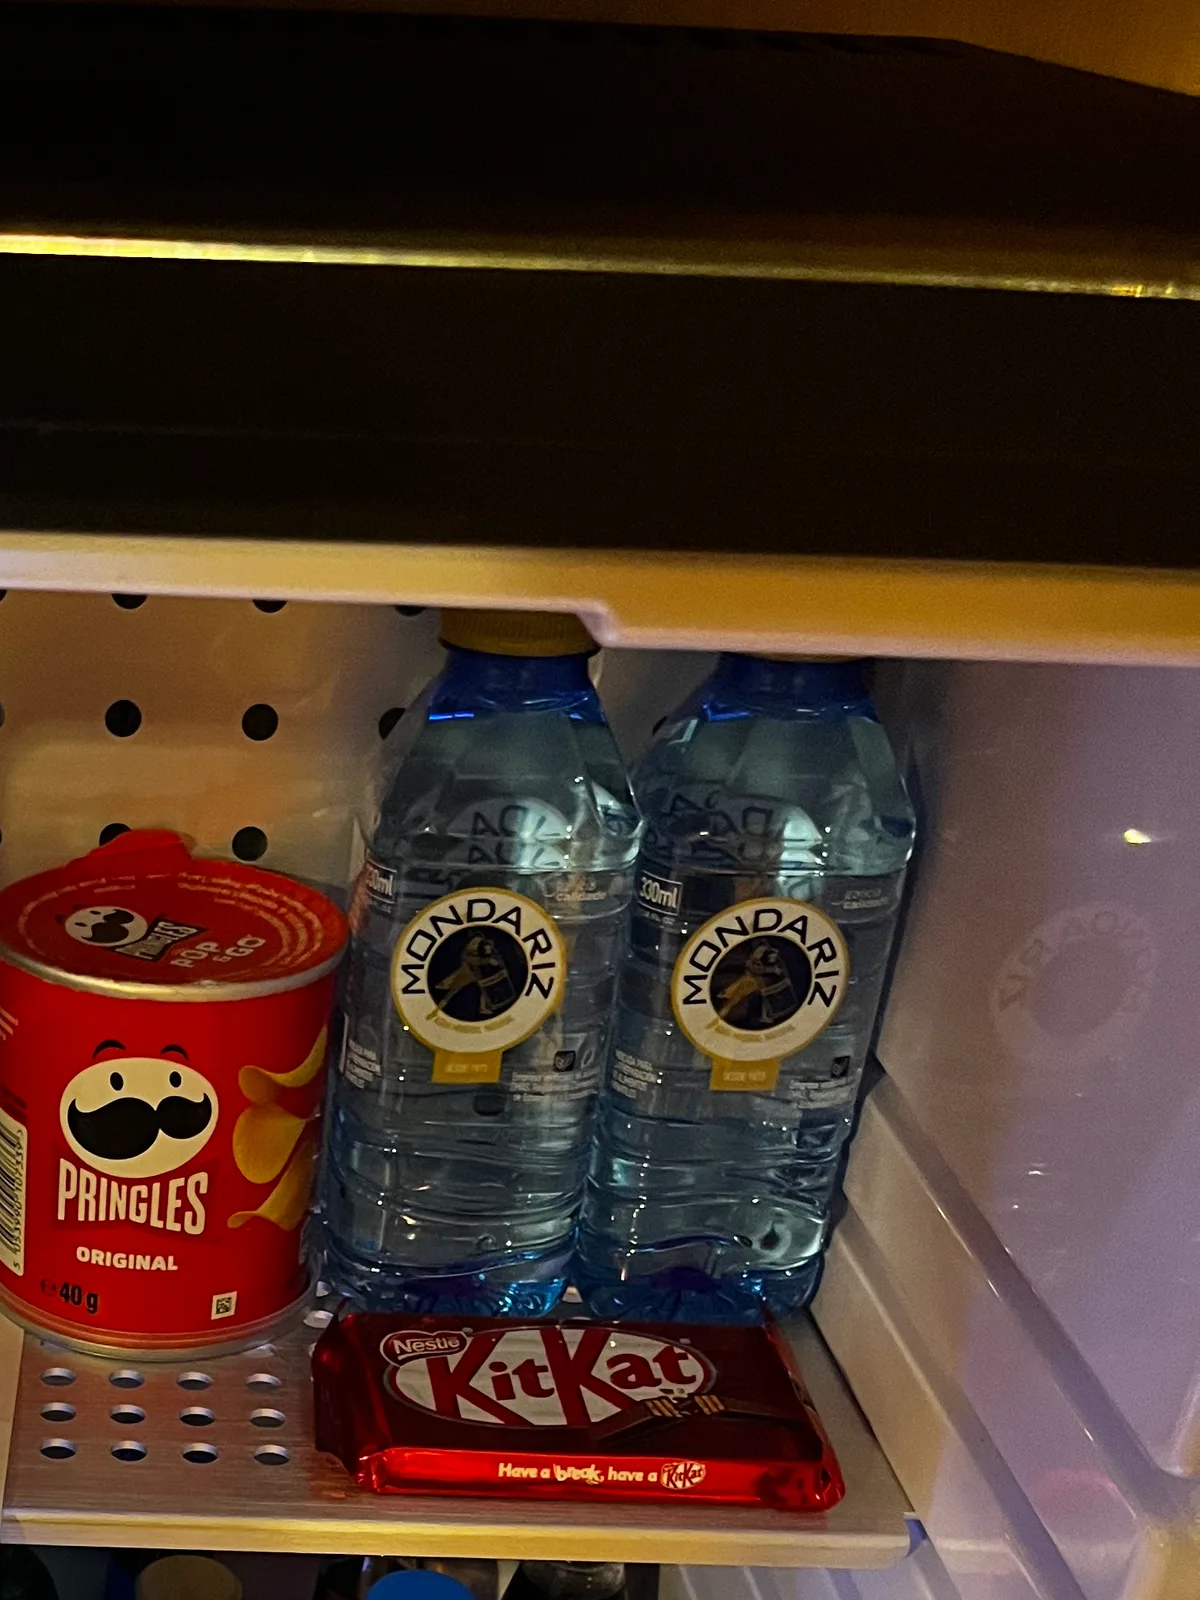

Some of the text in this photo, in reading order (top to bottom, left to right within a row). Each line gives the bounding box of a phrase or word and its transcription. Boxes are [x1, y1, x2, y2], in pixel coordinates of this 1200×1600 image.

[169, 941, 221, 968] POP
[401, 898, 555, 1000] MONDARIZ
[683, 908, 840, 1009] MONDARIZ
[57, 1158, 209, 1236] PRINGLES
[76, 1245, 179, 1272] ORIGINAL
[58, 1283, 99, 1315] 40 g
[426, 1328, 692, 1428] KitKat
[498, 1462, 538, 1479] Have
[541, 1466, 551, 1479] a
[607, 1466, 643, 1482] have
[647, 1471, 658, 1483] a
[663, 1462, 705, 1489] KitKat
